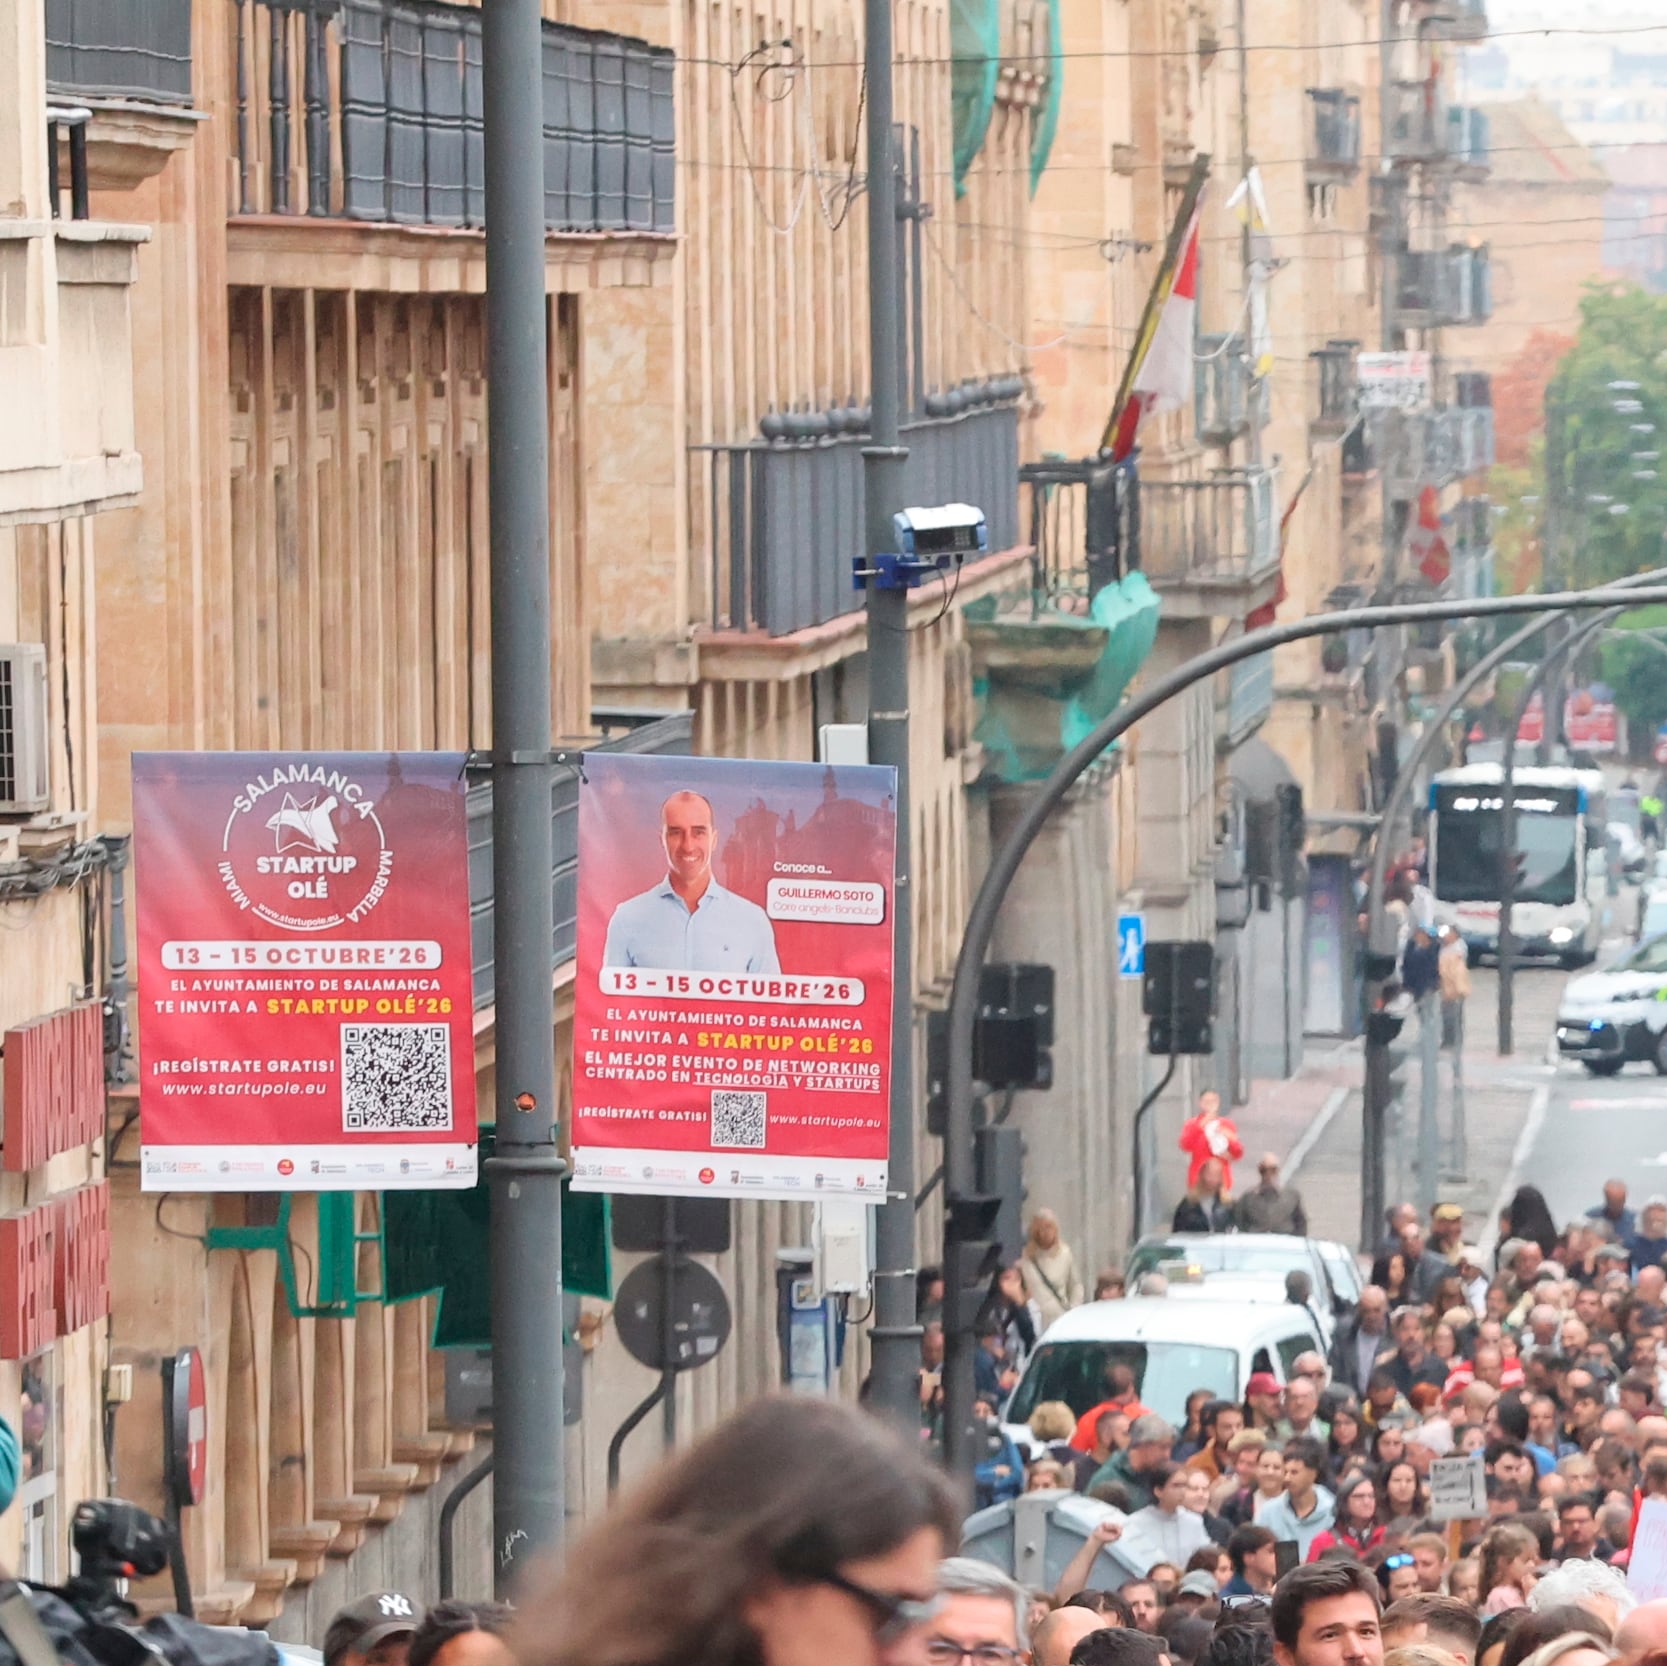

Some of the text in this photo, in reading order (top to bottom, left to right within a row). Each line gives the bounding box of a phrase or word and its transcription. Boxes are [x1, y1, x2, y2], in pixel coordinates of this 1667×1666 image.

[233, 764, 374, 820] SALAMANCA
[256, 856, 357, 874] STARTUP
[773, 861, 815, 873] Conoce
[218, 861, 250, 909] MIAMI
[288, 876, 328, 899] OLÉ
[347, 850, 393, 923] MARBELLA
[778, 887, 874, 902] GUILLERMO SOTO
[175, 947, 201, 964] 13
[232, 947, 256, 964] 15
[171, 978, 440, 992] EL AYUNTAMIENTO DE SALAMANCA
[613, 973, 637, 990] 13
[667, 975, 690, 992] 15
[155, 1000, 174, 1013] TE
[180, 1000, 240, 1013] INVITA
[245, 1000, 258, 1013] A
[267, 998, 369, 1014] STARTUP
[607, 1008, 862, 1031] EL AYUNTAMIENTO DE SALAMANCA
[591, 1028, 610, 1042] TE
[615, 1029, 674, 1045] INVITA
[678, 1032, 689, 1045] A
[697, 1032, 794, 1051] STARTUP
[153, 1057, 335, 1075] ¡REGÍSTRATE GRATIS!
[585, 1051, 880, 1076] EL MEJOR EVENTO DE NETWORKING
[22, 1002, 105, 1171] INMOBILIARIA
[586, 1066, 880, 1091] CENTRADO EN TECNOLOGÍA Y STARTUPS
[162, 1082, 327, 1097] www.startupole.eu
[578, 1105, 707, 1123] ¡REGÍSTRATE GRATIS!
[769, 1112, 881, 1129] www.startupole.eu
